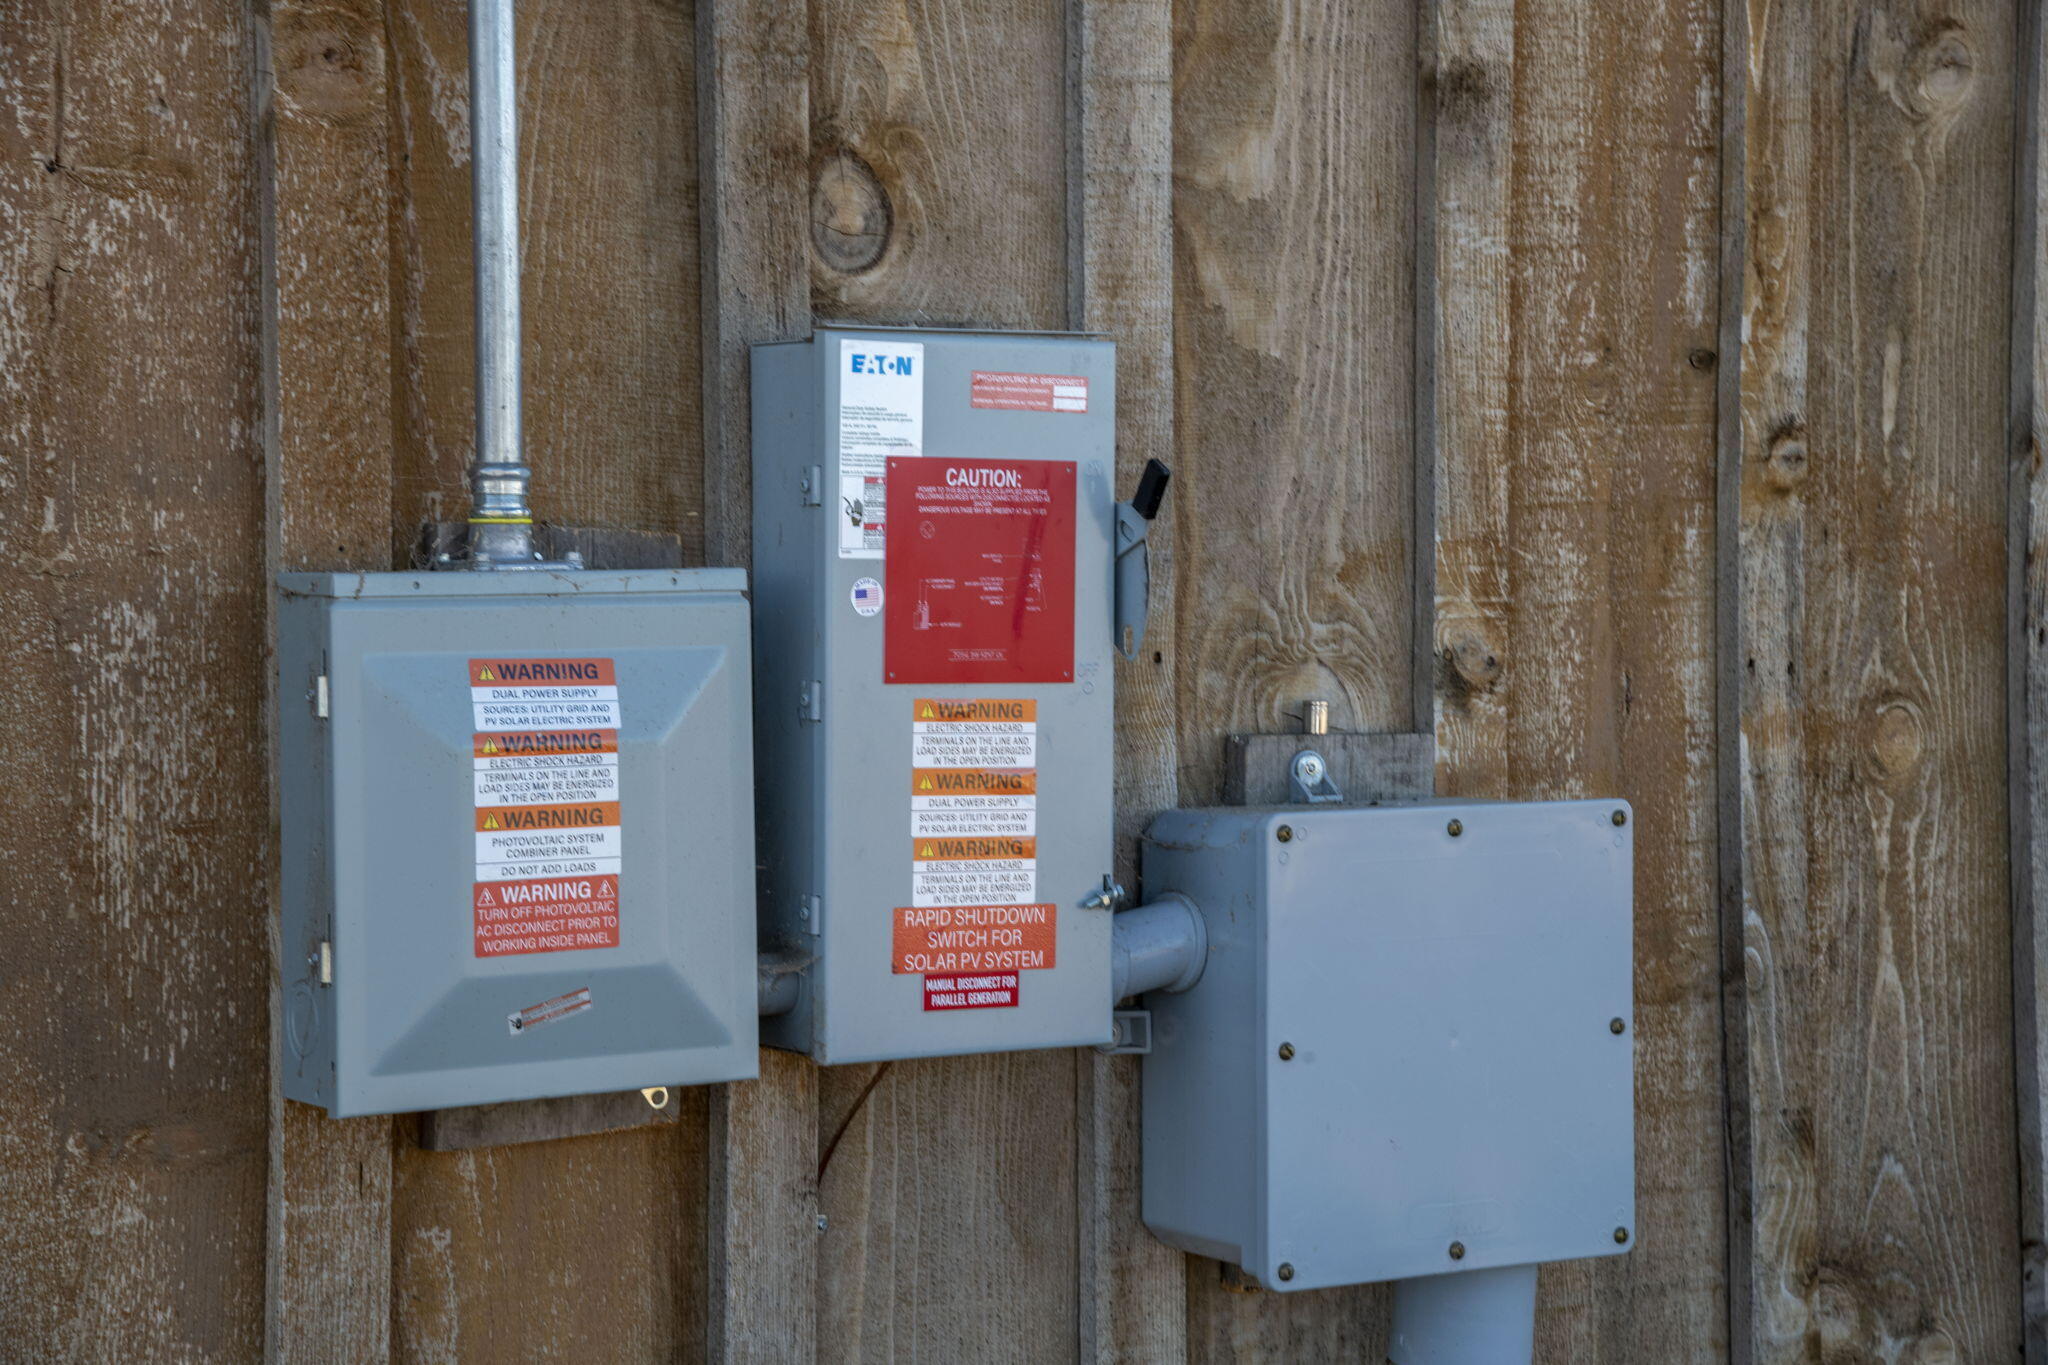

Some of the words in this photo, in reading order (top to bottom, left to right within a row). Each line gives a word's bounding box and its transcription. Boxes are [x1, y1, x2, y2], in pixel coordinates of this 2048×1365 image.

[852, 354, 912, 375] EATON
[946, 467, 1022, 487] CAUTION:
[497, 663, 599, 680] WARNING
[492, 690, 518, 699] DUAL
[523, 689, 559, 698] POWER
[562, 688, 598, 698] SUPPLY
[531, 705, 564, 713] UTILITY
[567, 705, 588, 713] GRID
[591, 704, 609, 712] AND
[937, 703, 1023, 719] WARNING
[500, 717, 530, 725] SOLAR
[532, 716, 574, 725] ELECTRIC
[577, 715, 611, 724] SYSTEM
[926, 724, 962, 732] ELECTRIC
[964, 724, 991, 732] SHOCK
[992, 724, 1023, 732] HAZARD
[501, 733, 603, 752] WARNING
[921, 737, 964, 745] TERMINALS
[965, 737, 977, 745] ON
[979, 737, 993, 745] THE
[995, 737, 1013, 745] LINE
[1014, 737, 1029, 745] AND
[916, 747, 937, 755] LOAD
[938, 747, 960, 755] SIDES
[962, 747, 977, 755] MAY
[979, 747, 989, 755] BE
[990, 746, 1031, 755] ENERGIZED
[490, 757, 531, 768] ELECTRIC
[534, 756, 564, 767] SHOCK
[567, 755, 603, 765] HAZARD
[933, 756, 942, 765] IN
[944, 756, 958, 765] THE
[959, 756, 980, 765] OPEN
[981, 756, 1017, 765] POSITION
[484, 771, 534, 782] TERMINALS
[536, 771, 549, 780] ON
[551, 770, 568, 780] THE
[570, 769, 590, 778] LINE
[592, 769, 611, 777] AND
[936, 774, 1022, 789] WARNING
[479, 784, 503, 794] LOAD
[505, 783, 531, 792] SIDES
[532, 782, 550, 791] MAY
[553, 782, 564, 790] BE
[566, 779, 613, 789] ENERGIZED
[500, 794, 509, 803] IN
[511, 793, 527, 802] THE
[529, 792, 553, 801] OPEN
[556, 790, 597, 800] POSITION
[929, 799, 951, 807] DUAL
[954, 798, 985, 807] POWER
[987, 798, 1018, 806] SUPPLY
[503, 808, 604, 828] WARNING
[960, 813, 988, 821] UTILITY
[990, 813, 1009, 821] GRID
[1011, 813, 1027, 821] AND
[919, 825, 930, 833] PV
[931, 825, 958, 833] SOLAR
[959, 824, 995, 832] ELECTRIC
[997, 824, 1027, 832] SYSTEM
[492, 834, 565, 847] PHOTOVOLTAIC
[567, 833, 604, 844] SYSTEM
[506, 848, 558, 859] COMBINER
[560, 846, 591, 856] PANEL
[937, 840, 1023, 857] WARNING
[501, 867, 515, 876] DO
[519, 866, 538, 875] NOT
[541, 864, 561, 873] ADD
[565, 862, 597, 872] LOADS
[926, 862, 962, 871] ELECTRIC
[964, 862, 991, 871] SHOCK
[992, 861, 1023, 869] HAZARD
[921, 876, 964, 885] TERMINALS
[965, 875, 976, 883] ON
[979, 875, 993, 883] THE
[1014, 874, 1029, 882] AND
[501, 881, 591, 904] WARNING
[916, 886, 937, 895] LOAD
[938, 885, 960, 894] SIDES
[962, 885, 977, 893] MAY
[979, 884, 989, 893] BE
[990, 883, 1031, 892] ENERGIZED
[933, 896, 943, 904] IN
[944, 895, 958, 903] THE
[959, 895, 980, 903] OPEN
[981, 894, 1017, 903] POSITION
[478, 908, 508, 921] TURN
[510, 906, 534, 919] OFF
[535, 901, 615, 918] PHOTOVOLTAIC
[904, 910, 950, 927] RAPID
[954, 907, 1046, 926] SHUTDOWN
[476, 925, 491, 937] AC
[494, 919, 566, 936] DISCONNECT
[568, 917, 600, 930] PRIOR
[602, 916, 616, 927] TO
[482, 938, 536, 953] WORKING
[539, 934, 574, 948] INSIDE
[577, 931, 611, 944] PANEL
[928, 931, 987, 948] SWITCH
[991, 930, 1023, 946] FOR
[904, 953, 956, 971] SOLAR
[960, 952, 981, 969] PV
[984, 950, 1043, 968] SYSTEM
[926, 978, 956, 992] MANUAL
[957, 976, 1001, 990] DISCONNECT
[1002, 975, 1016, 988] FOR
[931, 993, 966, 1007] PARALLEL
[968, 991, 1011, 1005] GENERATION
